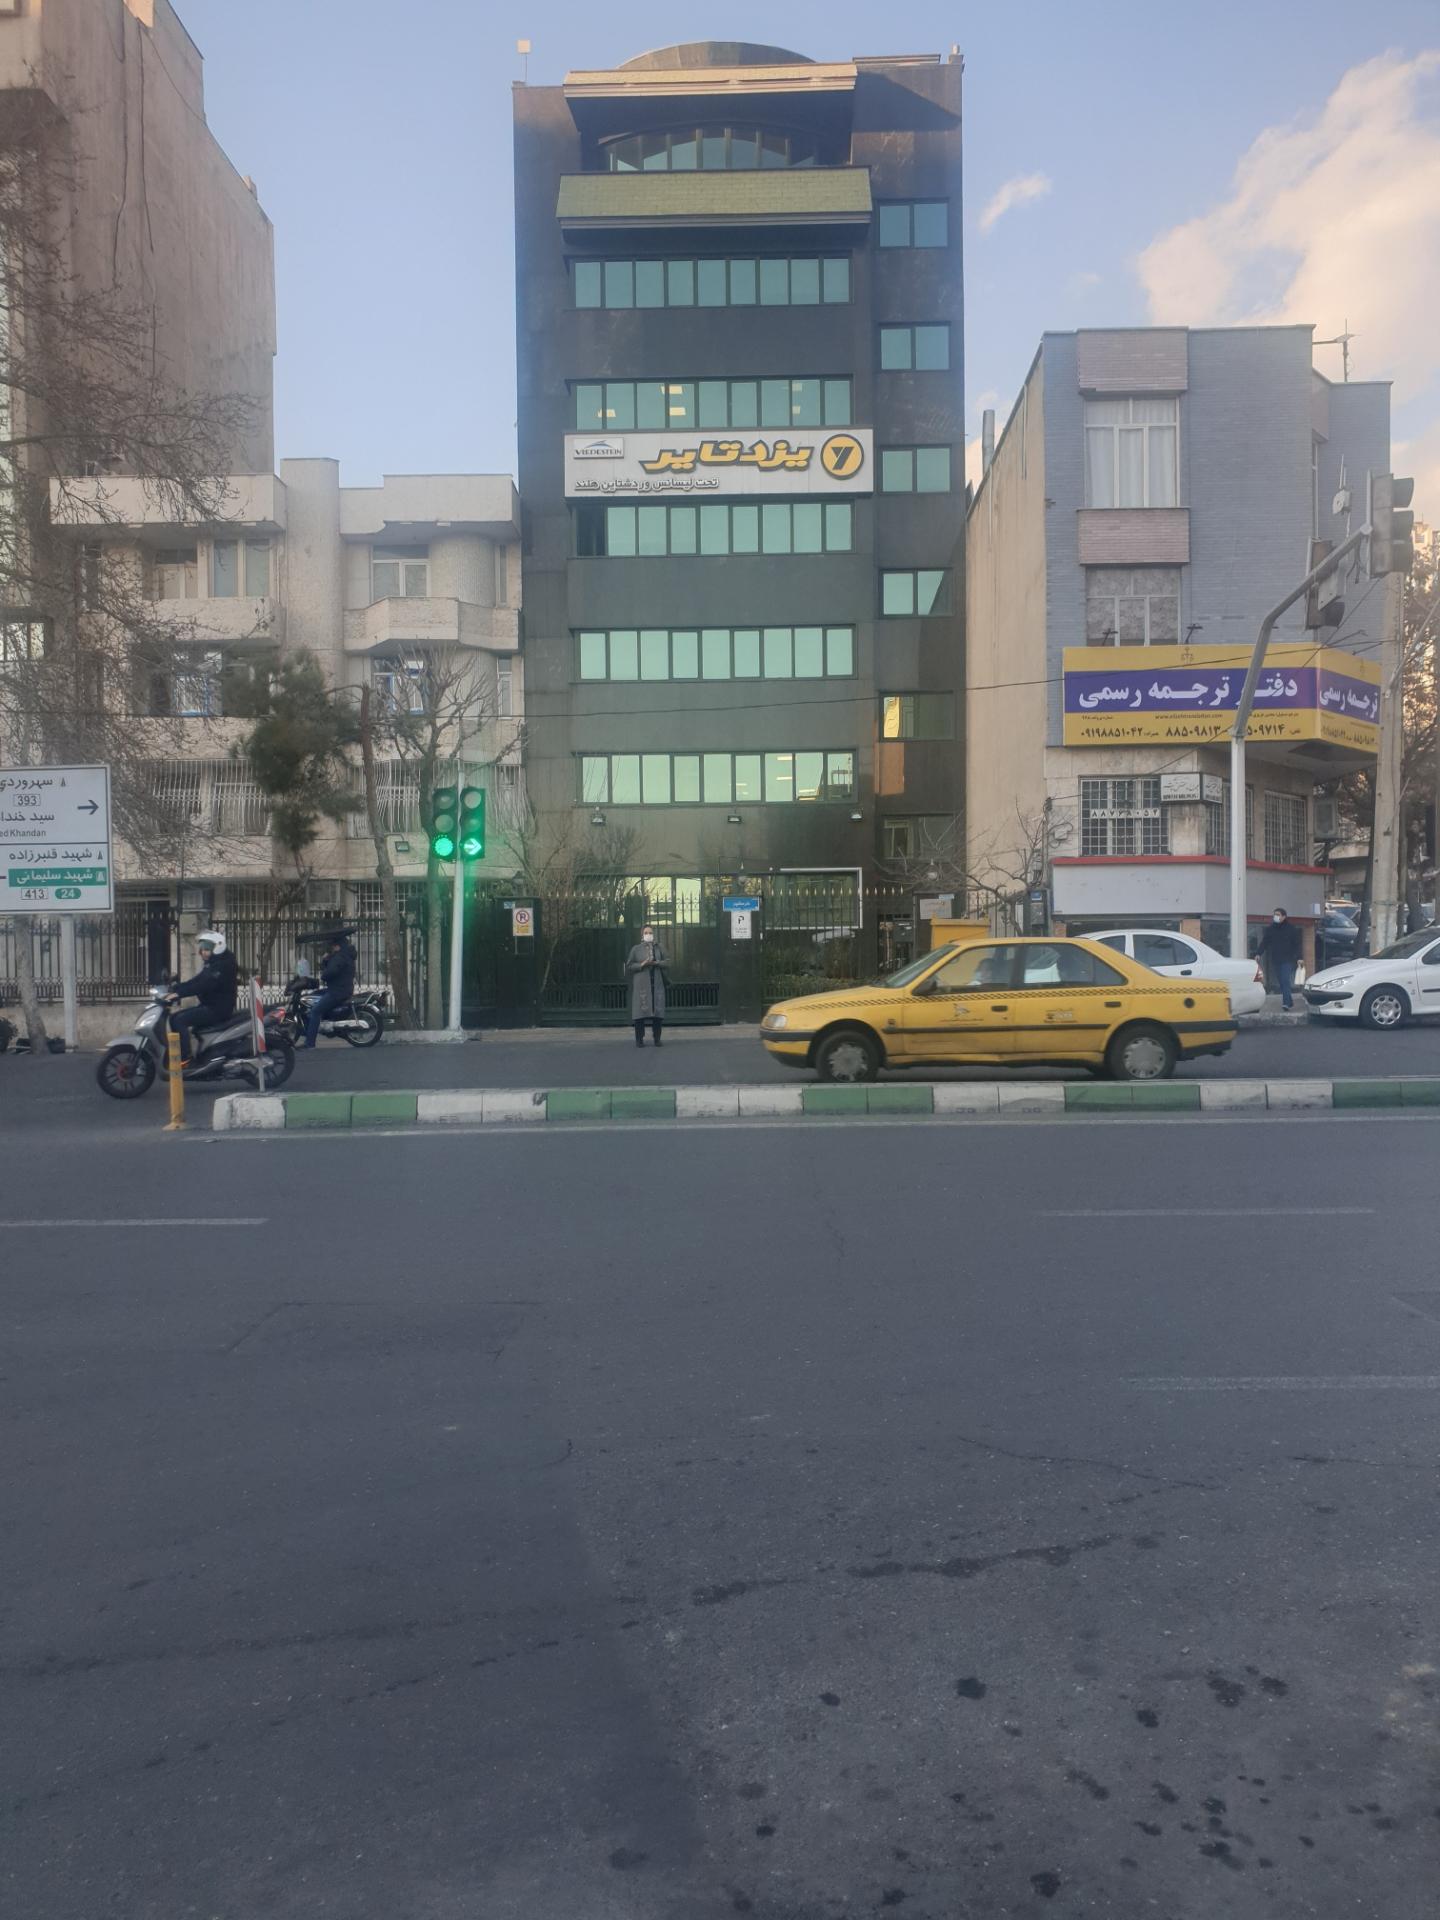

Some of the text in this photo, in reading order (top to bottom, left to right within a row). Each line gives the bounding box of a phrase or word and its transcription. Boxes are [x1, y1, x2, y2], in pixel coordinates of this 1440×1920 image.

[574, 479, 600, 491] هلند
[652, 477, 694, 492] لیسانس
[695, 477, 719, 489] تحت
[1078, 685, 1142, 708] رسمی
[1148, 676, 1230, 706] ترجمه
[1319, 687, 1346, 711] رسمی
[1247, 723, 1286, 736] ۵۰۹۷۱۴
[17, 795, 37, 806] 393
[0, 810, 55, 825] سید خندا
[10, 829, 46, 837] Khandan
[9, 848, 93, 863] شهید قنبرزاده
[16, 868, 93, 884] شهید سلیمانی
[24, 888, 75, 899] 413 24
